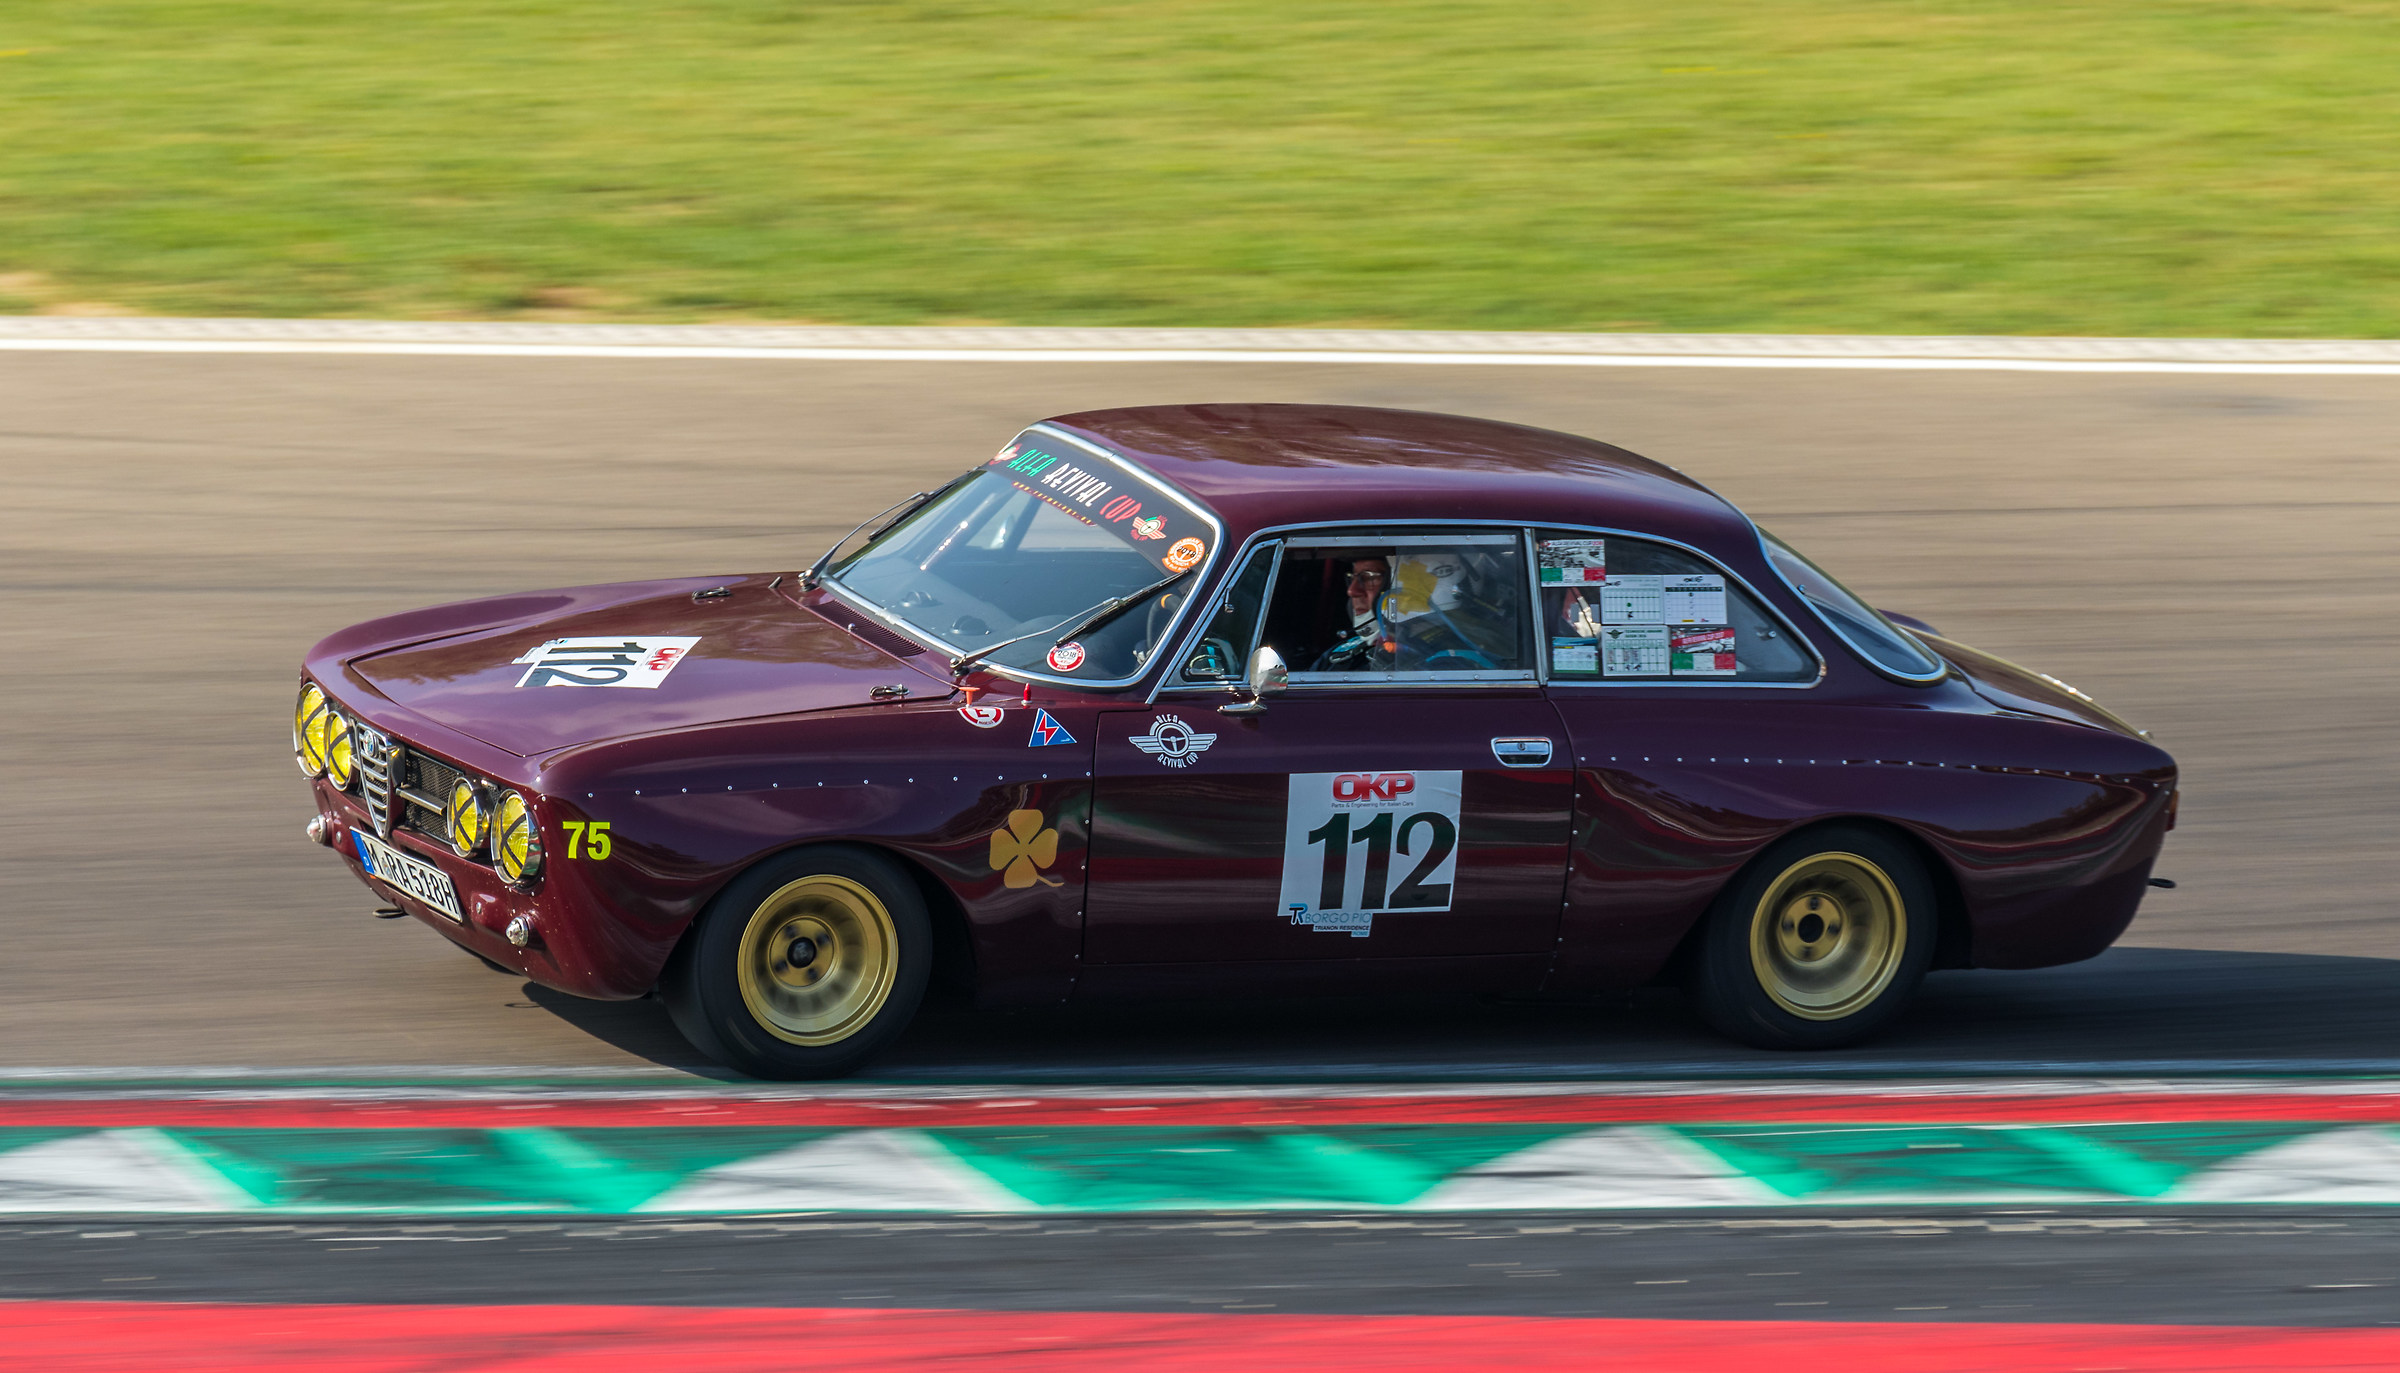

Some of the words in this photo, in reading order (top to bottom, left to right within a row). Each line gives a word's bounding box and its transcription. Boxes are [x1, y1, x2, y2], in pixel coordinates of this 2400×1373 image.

[1006, 449, 1057, 478] ALFA
[1041, 463, 1112, 507] REVIVAL
[1100, 495, 1142, 523] CUP
[1176, 546, 1197, 558] 2018
[523, 642, 647, 687] 112
[646, 648, 684, 671] OKP
[1155, 714, 1178, 724] ALFA
[1157, 753, 1187, 768] REVIVAL
[1186, 752, 1199, 765] CUP
[1333, 773, 1415, 802] OKP
[562, 821, 611, 861] 75
[1307, 811, 1456, 910] 112
[1305, 912, 1350, 923] BORGO
[1352, 912, 1372, 923] PIO
